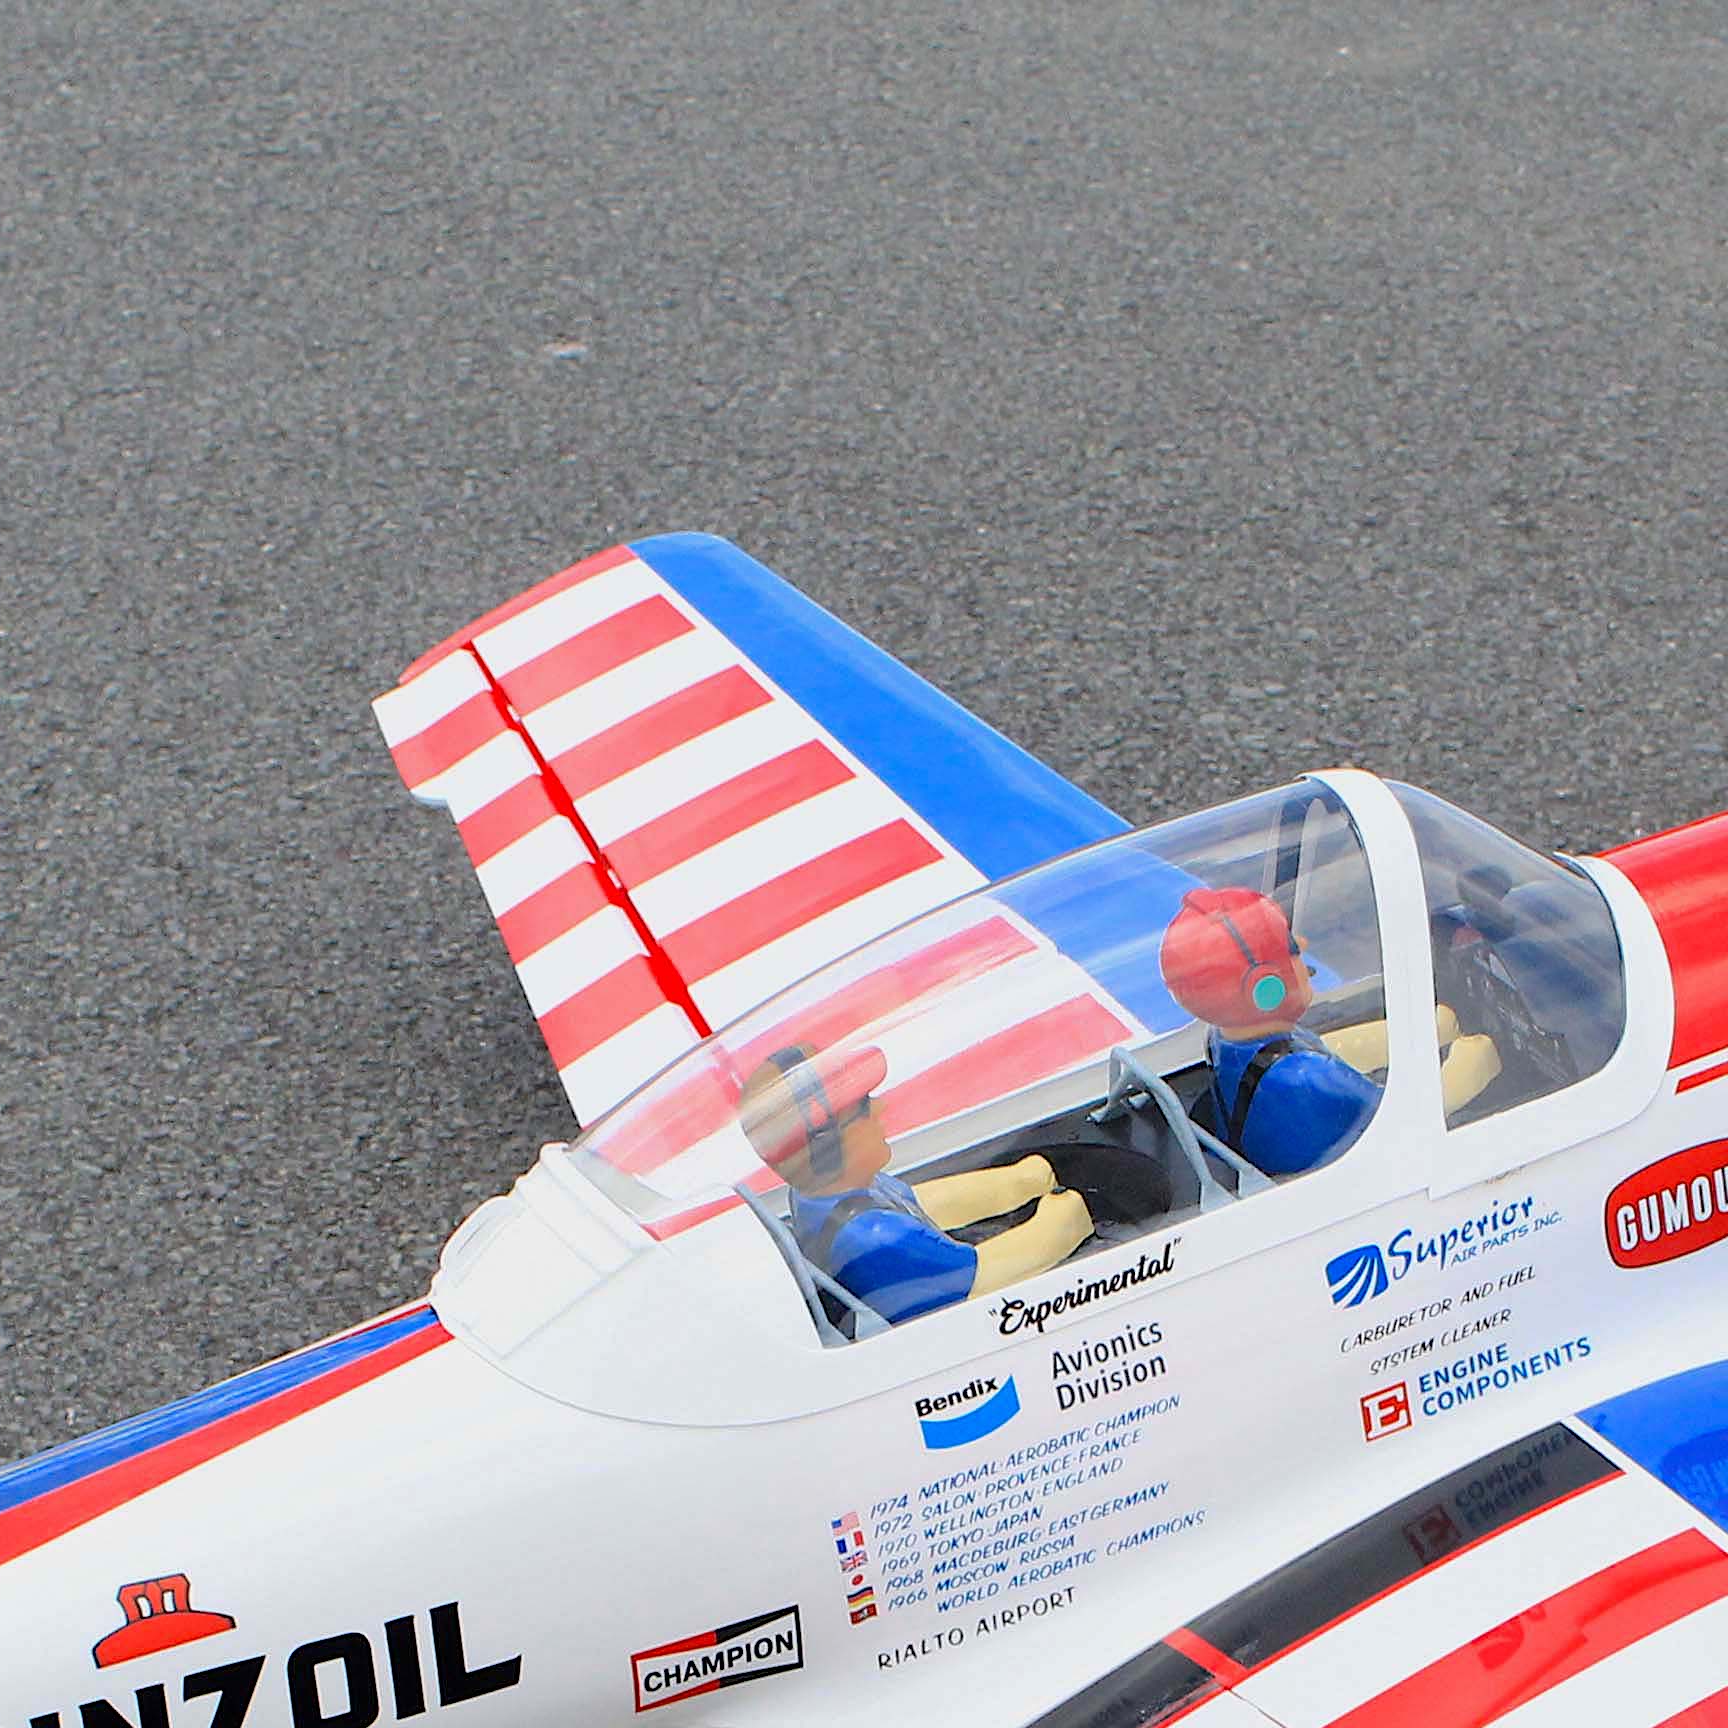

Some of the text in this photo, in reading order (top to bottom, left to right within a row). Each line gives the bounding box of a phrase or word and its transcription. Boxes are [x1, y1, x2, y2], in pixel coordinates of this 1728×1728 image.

[1388, 1195, 1534, 1281] Superior
[1451, 1211, 1563, 1266] AIR PARTS INC.
[1341, 1264, 1536, 1353] CARBURETOR AND FUEL
[1441, 1308, 1512, 1347] CLEANER
[1051, 1322, 1163, 1379] Avionics
[1418, 1343, 1510, 1393] ENGINE
[1422, 1336, 1593, 1417] COMPONENTS
[915, 1377, 999, 1418] Bendix
[1056, 1355, 1167, 1411] Division
[870, 1493, 909, 1520] 1974
[1094, 1394, 1181, 1437] CHAMPION
[874, 1512, 913, 1539] 1972
[878, 1532, 918, 1557] 1970
[882, 1551, 921, 1576] 1969
[885, 1569, 924, 1595] 1968
[888, 1534, 1075, 1612] 1966 MOSCOW RUSSIA
[936, 1510, 1207, 1613] WORLD AEROBATIC CHAMPIONS
[877, 1586, 1077, 1671] RIALTO AIRPORT
[643, 1629, 794, 1694] CHAMPION
